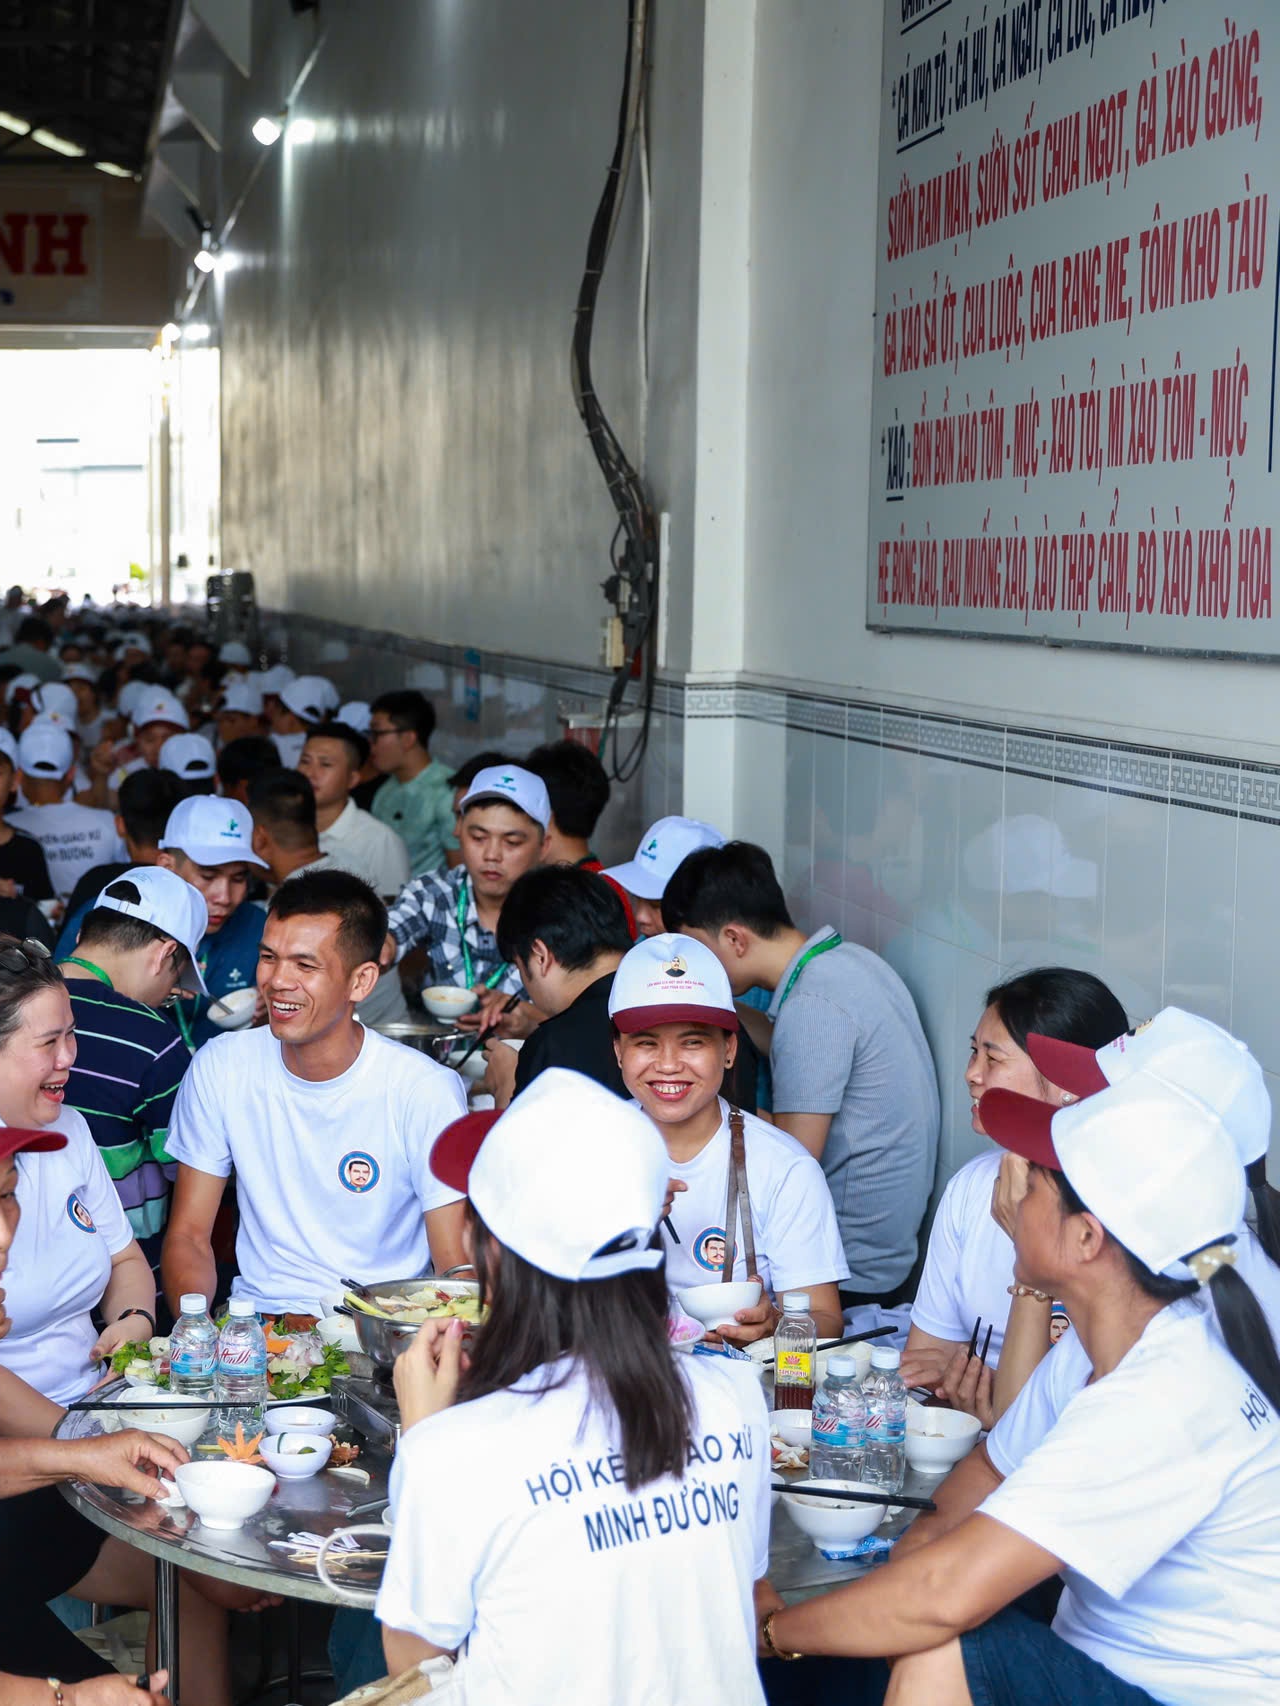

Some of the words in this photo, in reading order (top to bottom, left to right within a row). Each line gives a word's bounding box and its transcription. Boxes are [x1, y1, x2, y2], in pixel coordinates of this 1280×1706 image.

[897, 53, 910, 142] CÁ
[911, 58, 932, 135] KHO
[955, 15, 969, 112] CÁ
[917, 174, 942, 251] RAM
[976, 128, 1010, 228] SƯỜN
[1012, 101, 1040, 214] SỐT
[1042, 111, 1080, 203] CHUA
[1084, 89, 1129, 196] NGỌT,
[1135, 52, 1157, 167] GÀ
[1161, 38, 1200, 156] XÀO
[1204, 17, 1263, 142] GỪNG,
[884, 292, 897, 377] GÀ
[899, 288, 921, 373] XÀO
[923, 270, 938, 368] SẢ
[962, 283, 985, 358] CUA
[988, 253, 1026, 363] LUỘC,
[1030, 260, 1056, 342] CUA
[1060, 244, 1101, 334] RANG
[1104, 236, 1132, 336] ME,
[1139, 202, 1177, 314] TÔM
[1180, 207, 1221, 305] KHO
[1227, 173, 1268, 294] TÀU
[956, 393, 978, 483] XÀO
[980, 388, 1004, 480] TÔM
[1013, 386, 1040, 493] MỰC
[1049, 374, 1075, 474] XÀO
[1079, 357, 1103, 486] TỎI,
[1107, 363, 1125, 468] MÌ
[1127, 358, 1158, 465] XÀO
[1162, 351, 1197, 462] TÔM
[1209, 346, 1248, 477] MỰC
[891, 522, 916, 605] BÔNG
[942, 538, 962, 608] RAU
[964, 507, 1002, 609] MUỐNG
[1032, 513, 1058, 611] XÀO
[1061, 511, 1095, 628] THẬP
[1135, 507, 1157, 615] BÒ
[1160, 506, 1193, 617] XÀO
[1196, 478, 1235, 620] KHỔ
[1236, 526, 1271, 620] HOA
[525, 1458, 582, 1506] HỘI
[586, 1446, 627, 1489] KÈ
[728, 1423, 753, 1461] XỨ
[583, 1503, 651, 1553] MINH
[652, 1476, 739, 1535] ĐƯỜNG
